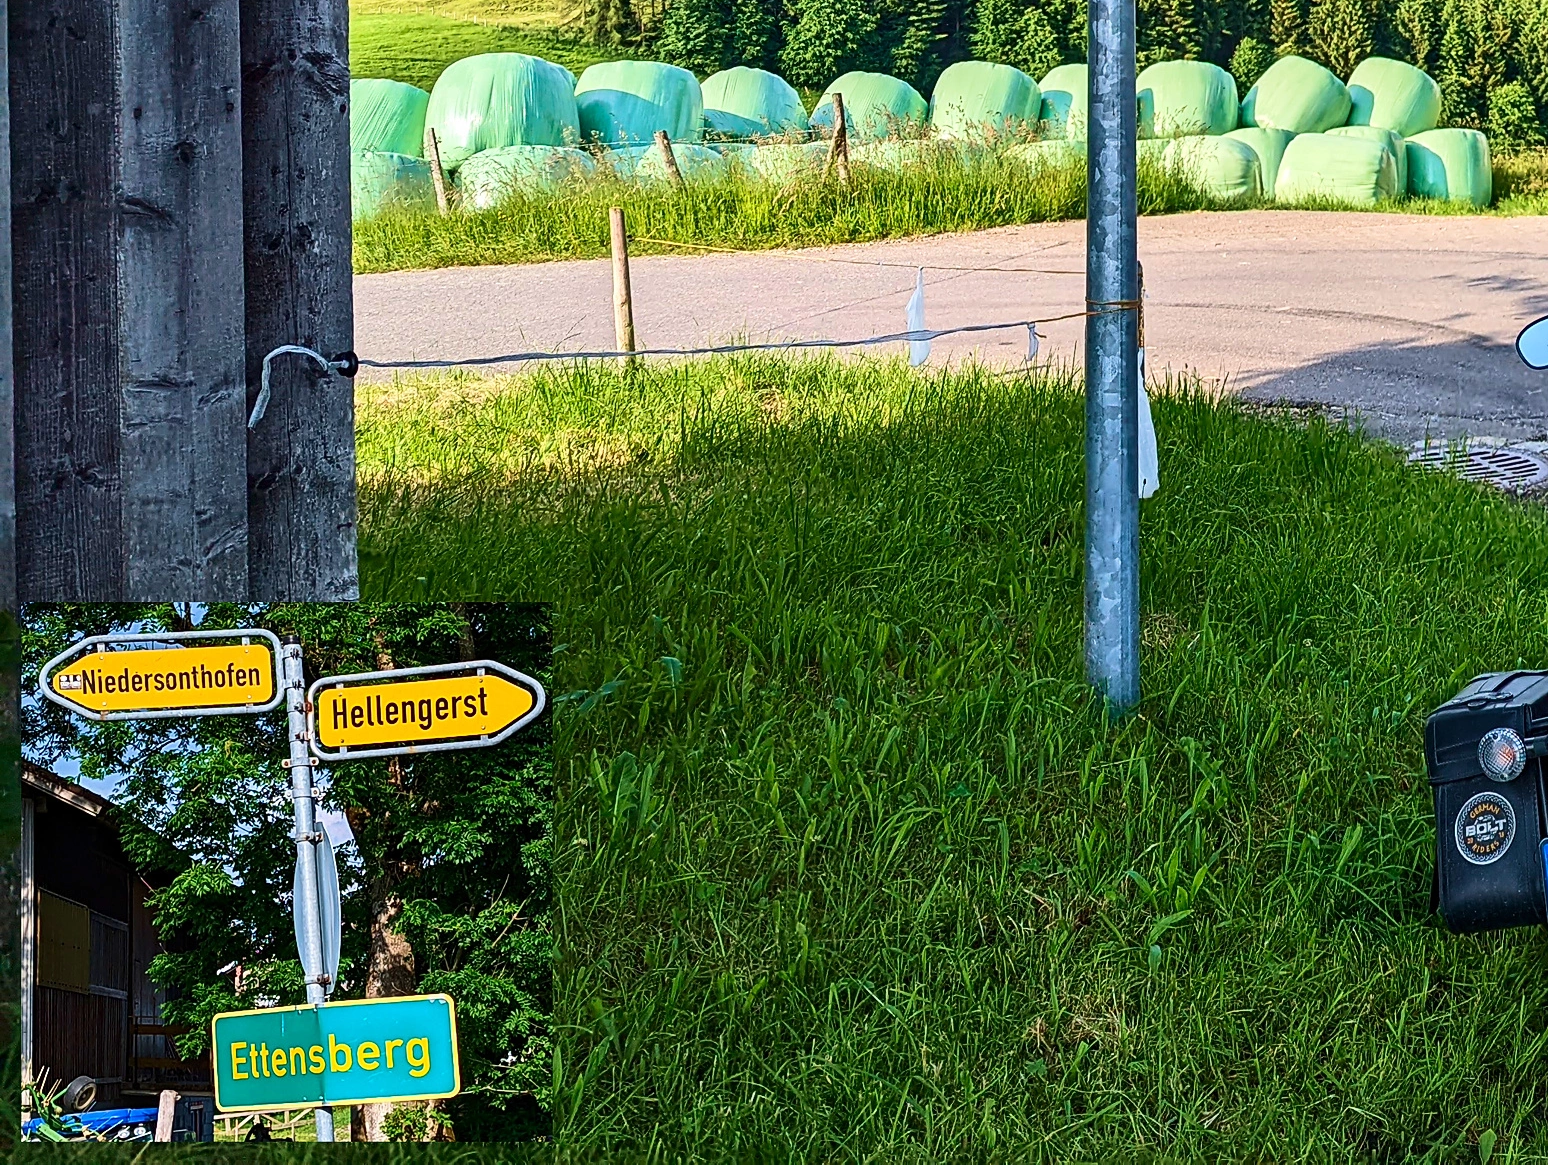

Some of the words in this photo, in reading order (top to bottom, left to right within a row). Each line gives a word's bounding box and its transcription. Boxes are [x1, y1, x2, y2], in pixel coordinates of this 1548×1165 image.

[81, 662, 261, 694] Niedersonthofen
[332, 688, 488, 730] Hellengerst
[1470, 803, 1500, 819] GERMAN
[1466, 819, 1507, 837] BOLT
[1472, 840, 1500, 853] RIDERS
[230, 1033, 431, 1082] Ettensberg
